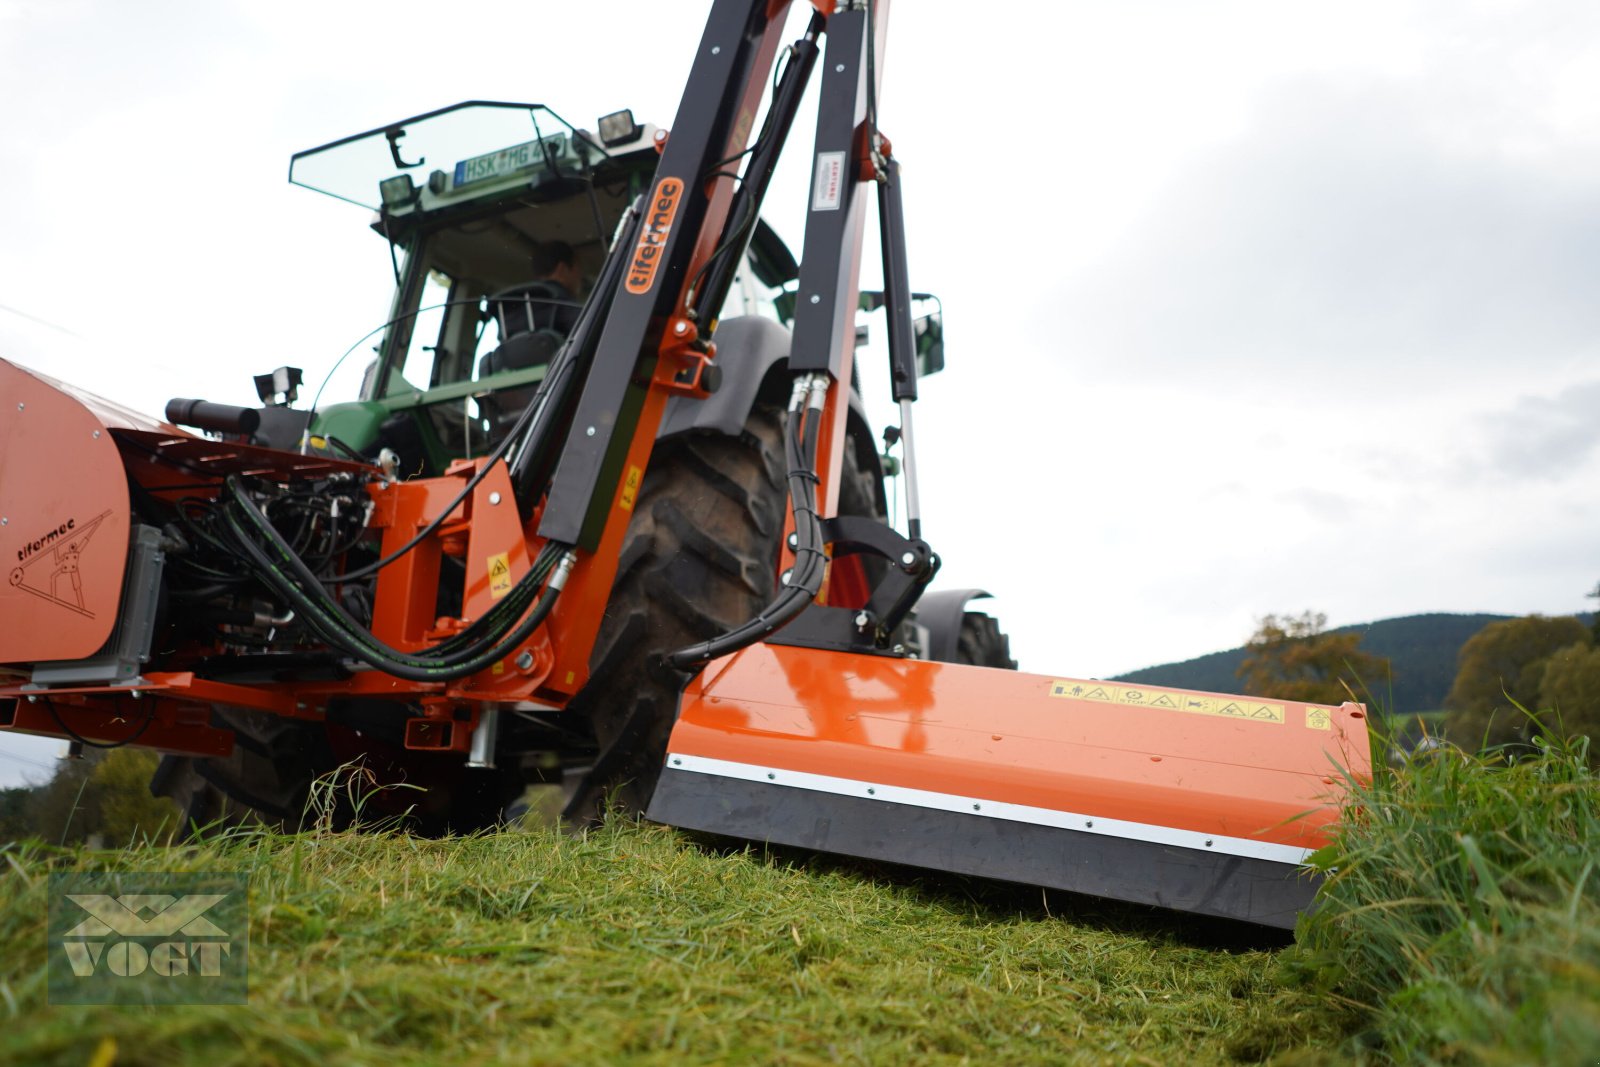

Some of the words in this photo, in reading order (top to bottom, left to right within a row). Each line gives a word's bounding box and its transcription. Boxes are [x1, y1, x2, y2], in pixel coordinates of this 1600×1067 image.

[466, 156, 497, 180] HSK
[508, 145, 530, 168] MG
[629, 183, 677, 287] tifermec
[17, 518, 75, 561] tifermec
